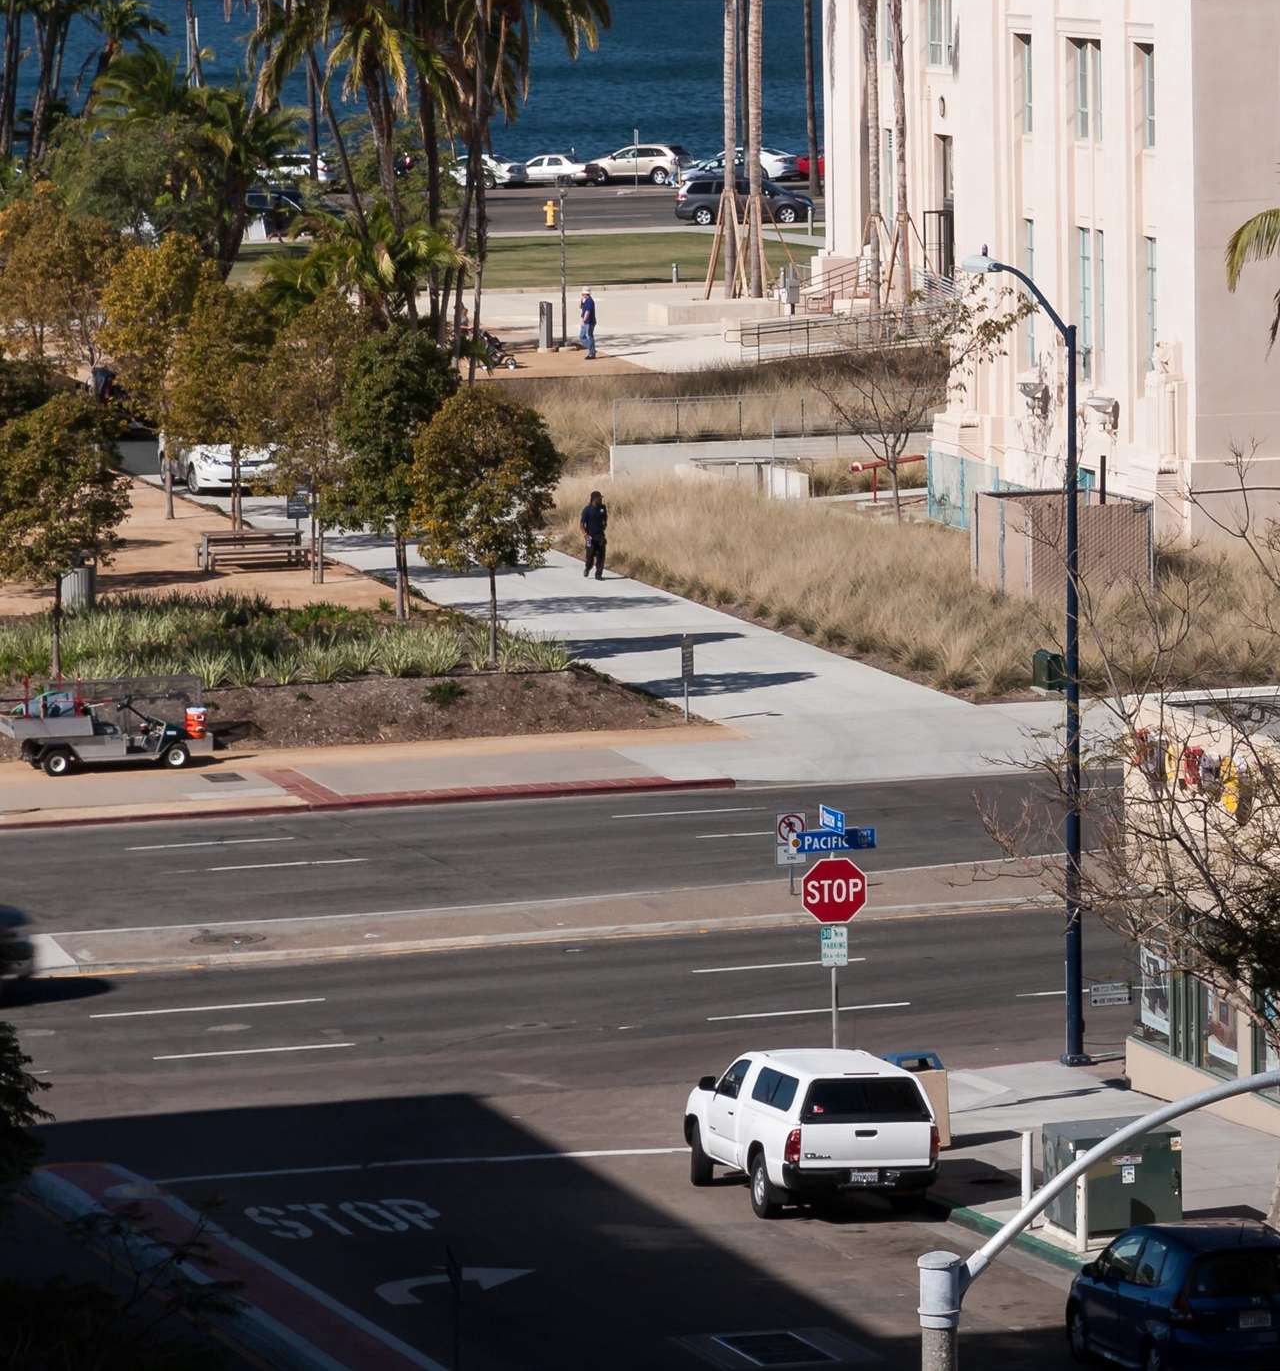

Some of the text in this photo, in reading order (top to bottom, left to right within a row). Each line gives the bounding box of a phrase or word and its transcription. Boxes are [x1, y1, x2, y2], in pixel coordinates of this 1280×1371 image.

[804, 835, 849, 850] PACIFIC
[806, 878, 862, 904] STOP
[243, 1199, 441, 1239] STOP
